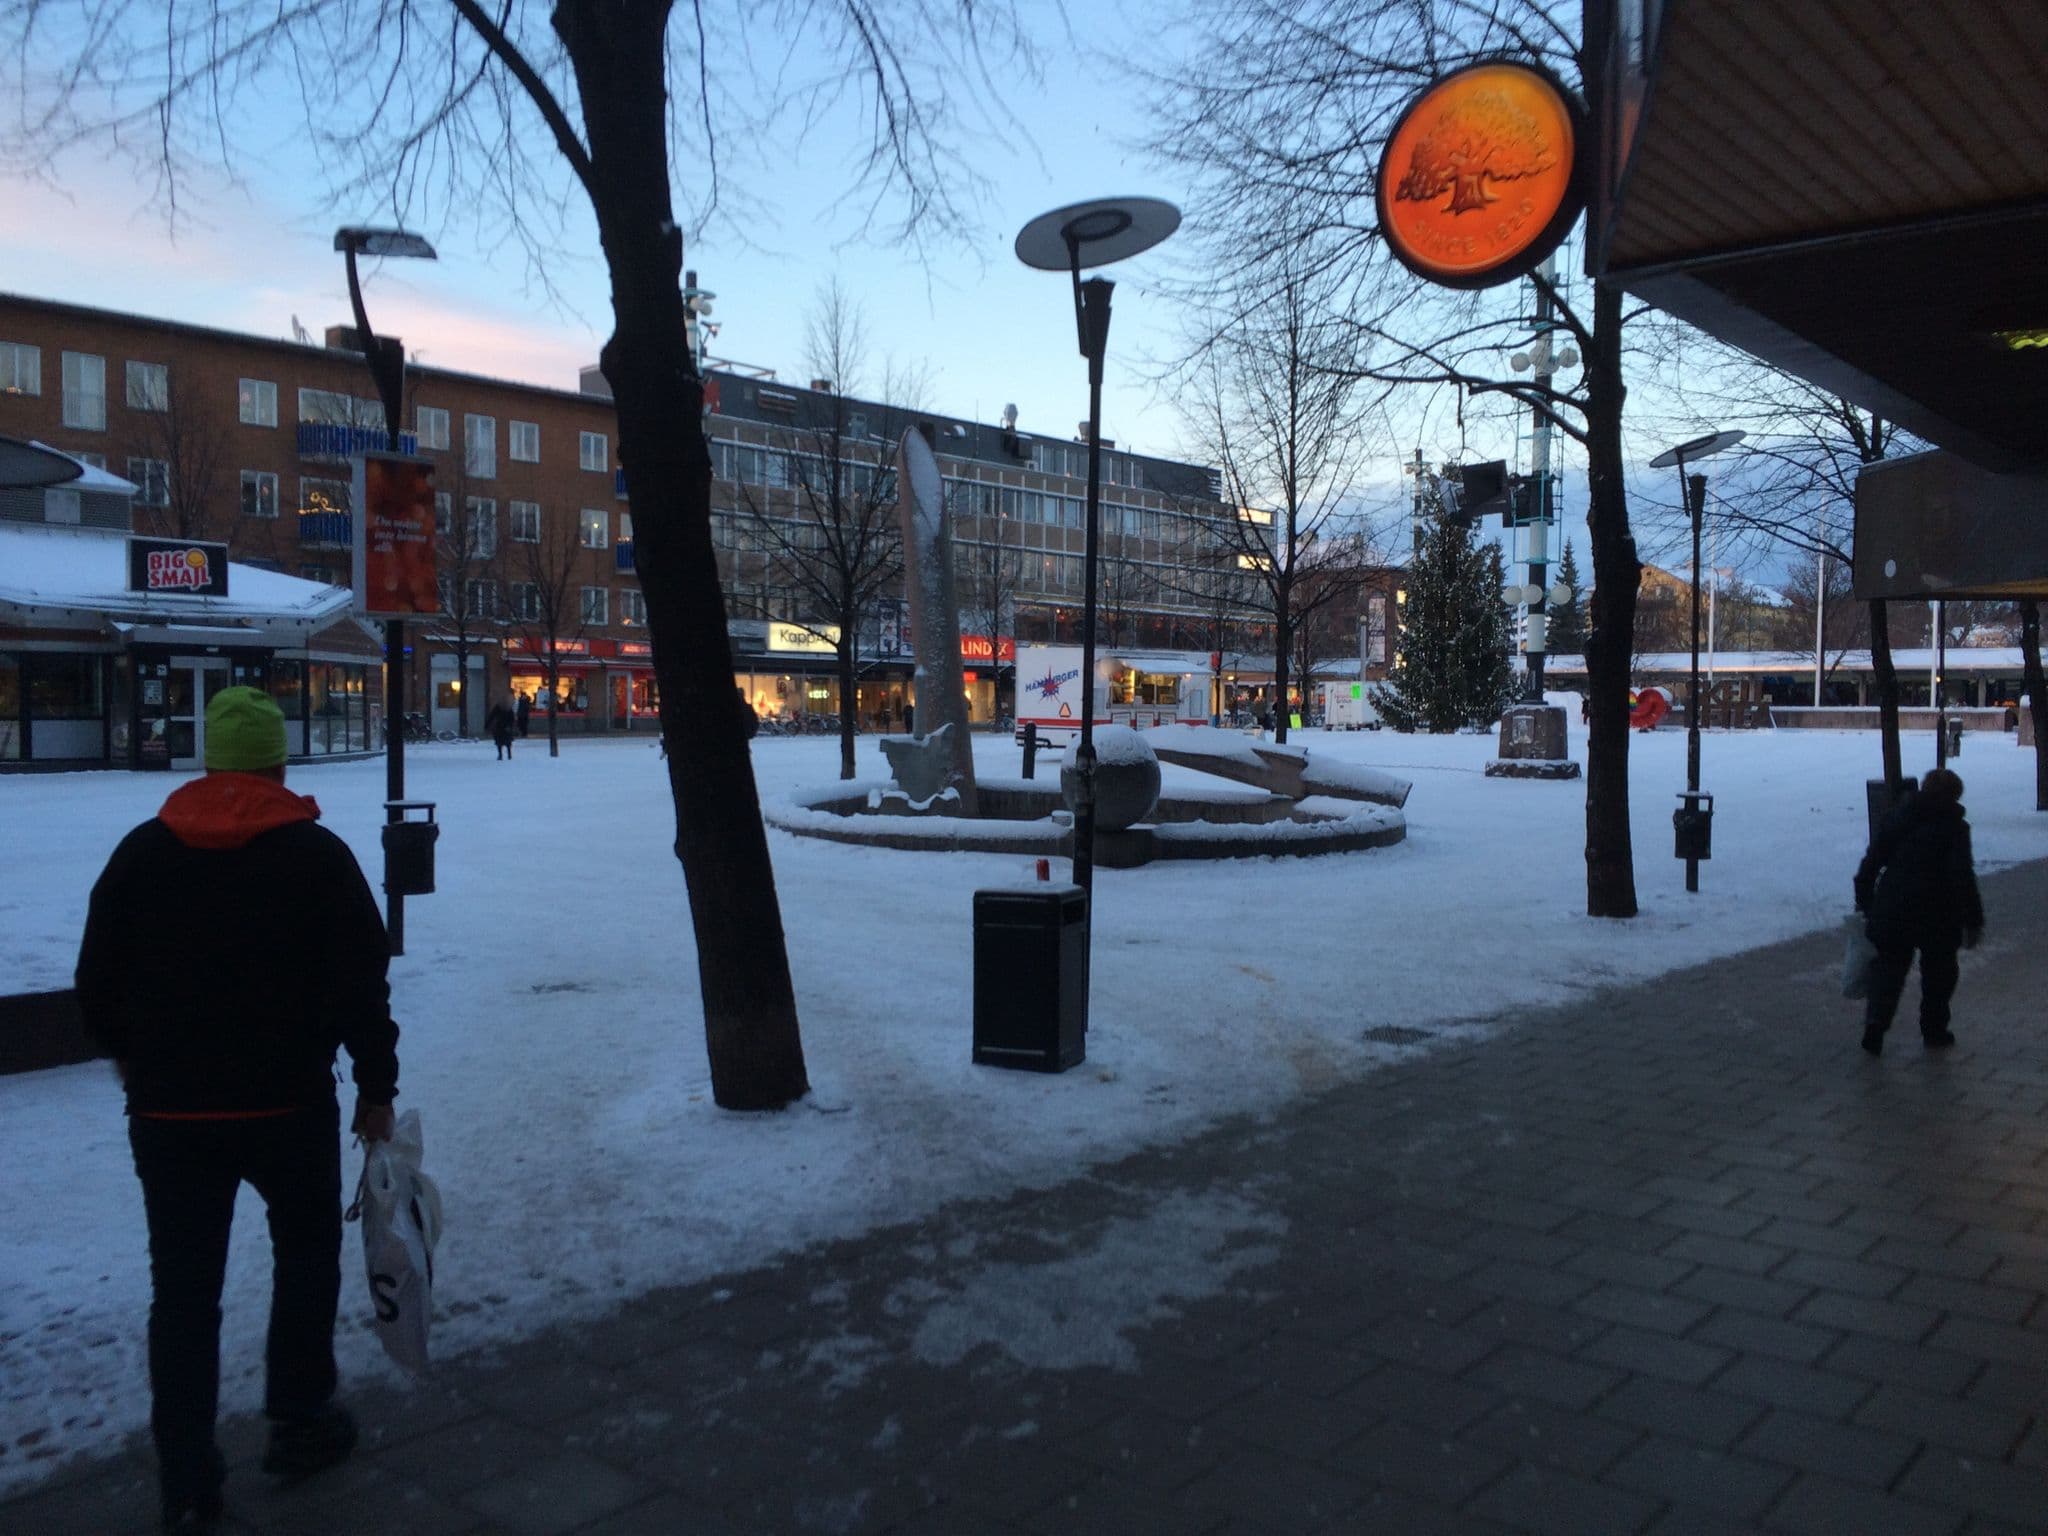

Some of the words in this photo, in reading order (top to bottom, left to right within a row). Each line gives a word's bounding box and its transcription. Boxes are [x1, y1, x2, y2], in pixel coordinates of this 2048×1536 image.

[149, 552, 184, 570] BIG
[149, 567, 209, 588] SMAJL
[961, 640, 1008, 656] LINDX
[1025, 669, 1079, 692] HAMRGER
